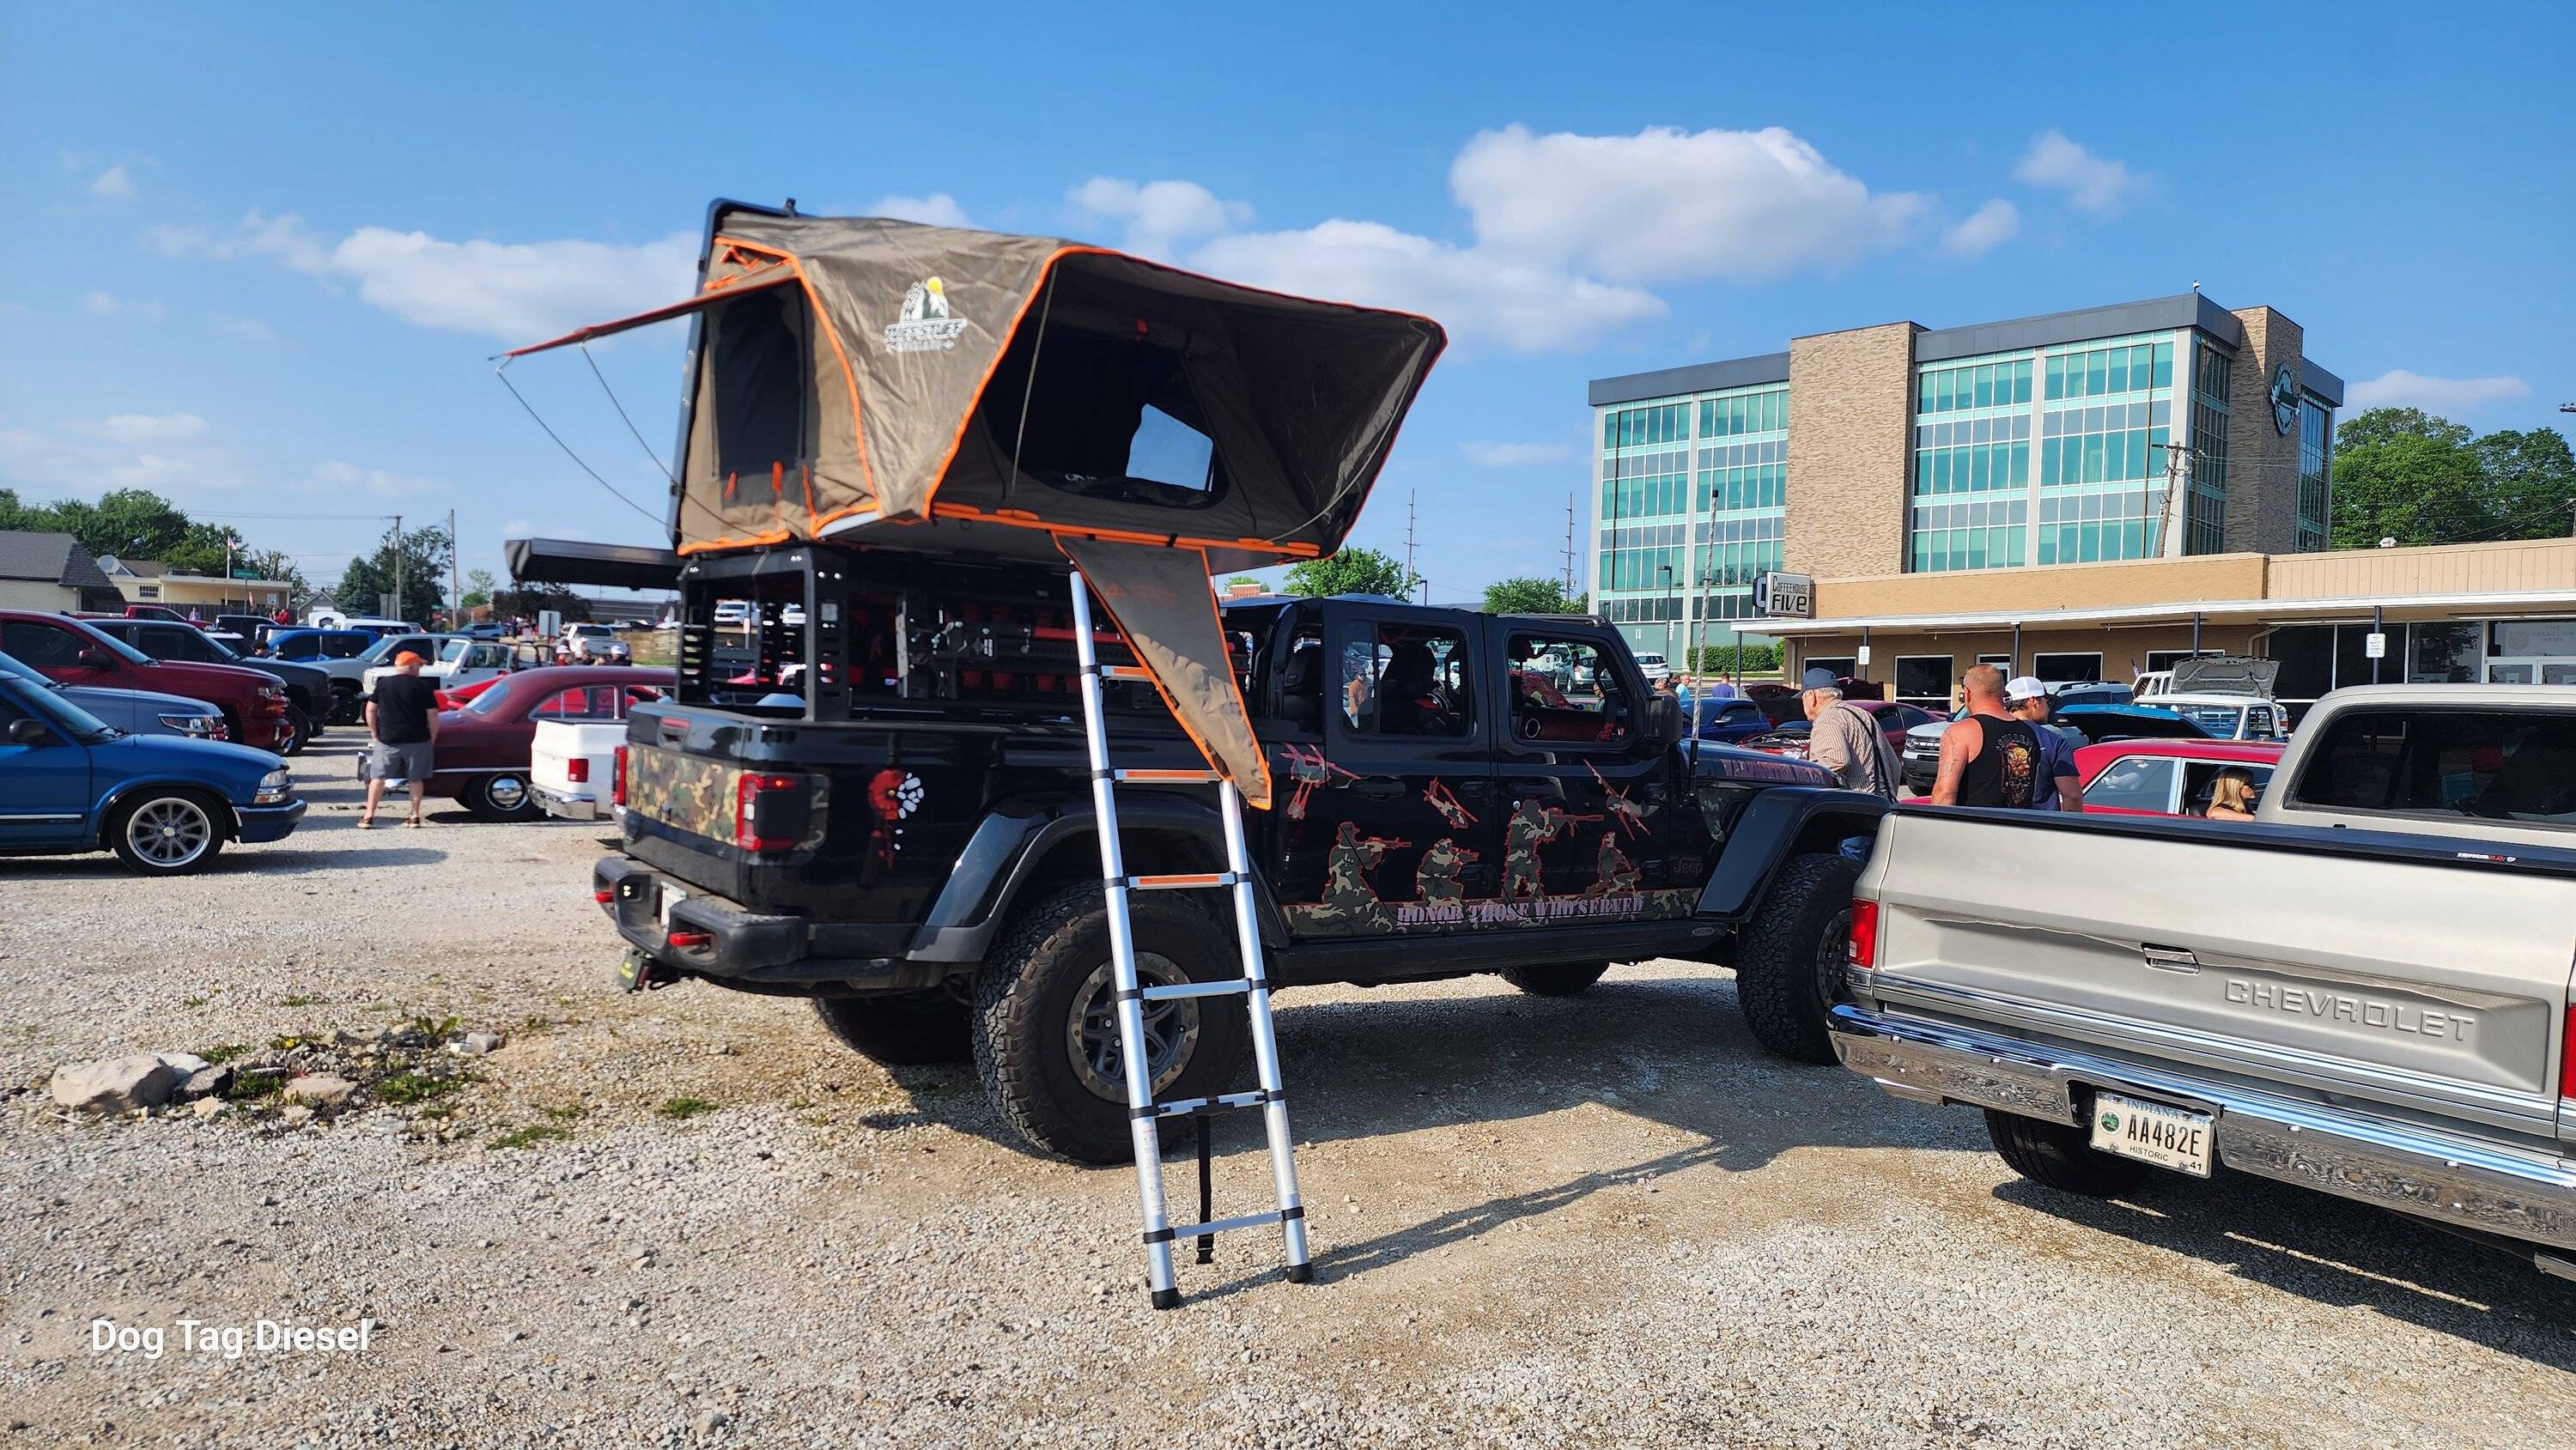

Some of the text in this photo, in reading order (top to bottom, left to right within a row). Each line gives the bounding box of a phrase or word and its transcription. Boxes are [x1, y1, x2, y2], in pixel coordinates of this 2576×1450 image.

[1396, 896, 1643, 925] HONOR THOSE WHO SERVED
[2225, 979, 2475, 1041] CHEVROLET
[2126, 1098, 2179, 1119] INDIANA
[2127, 1113, 2202, 1157] AA482E
[2129, 1145, 2169, 1162] HISTORIC
[2189, 1161, 2202, 1171] 41
